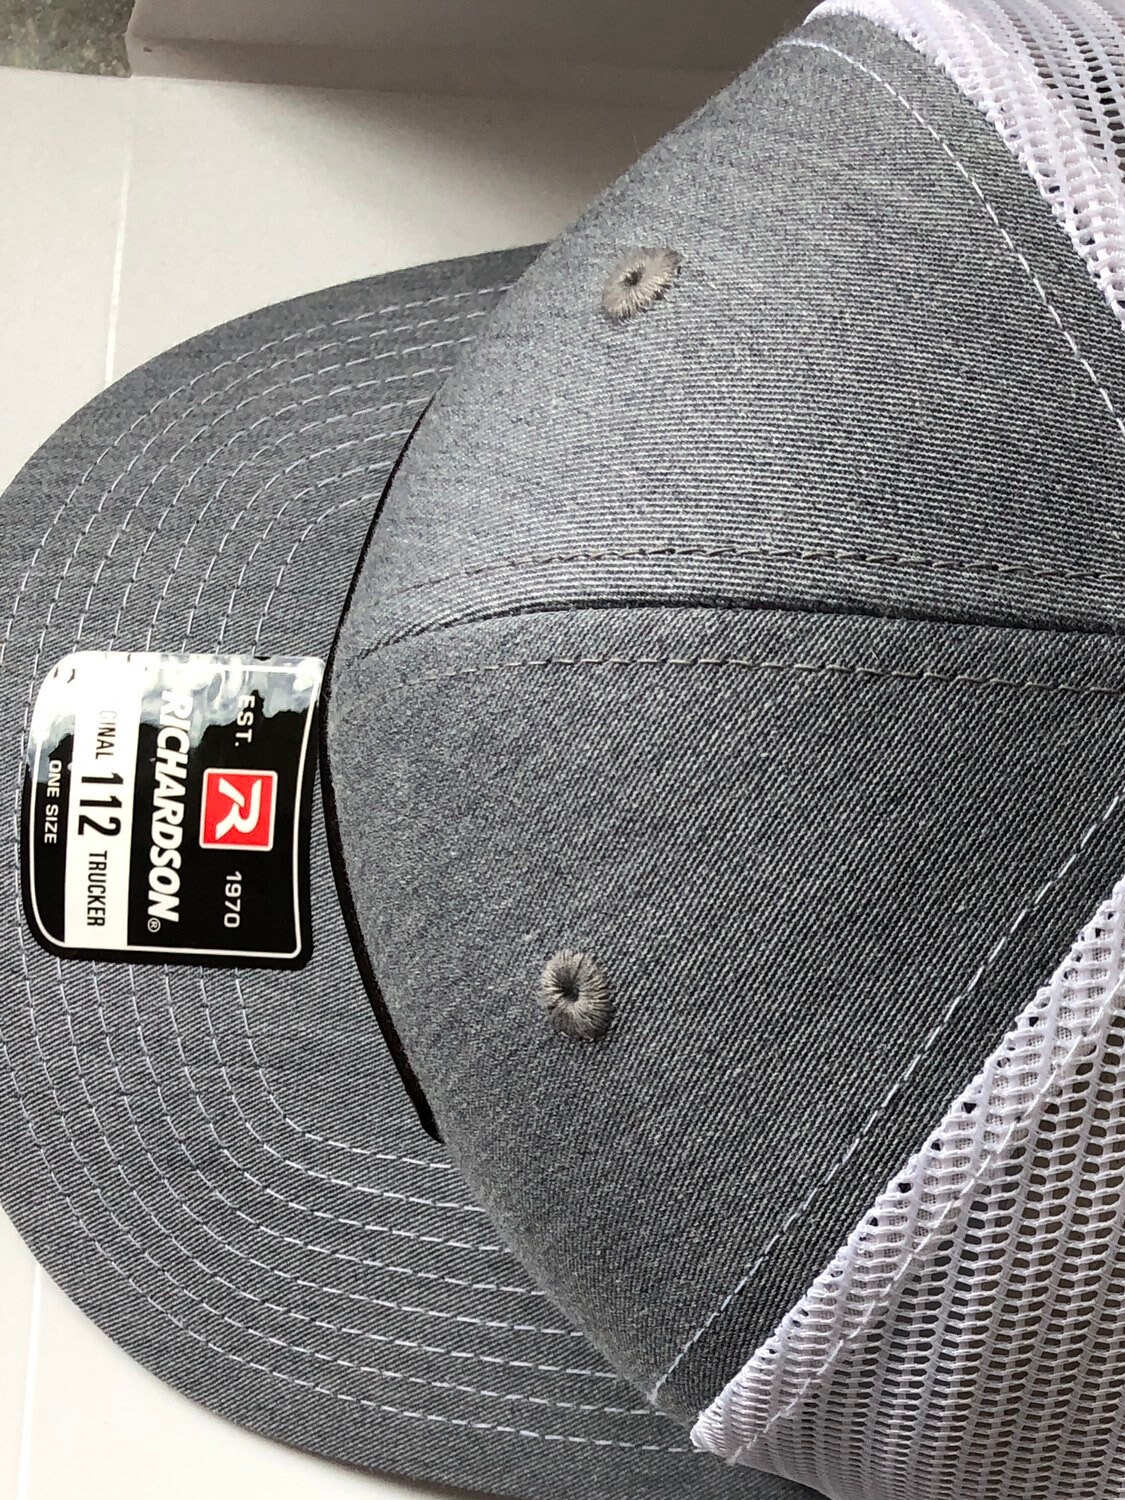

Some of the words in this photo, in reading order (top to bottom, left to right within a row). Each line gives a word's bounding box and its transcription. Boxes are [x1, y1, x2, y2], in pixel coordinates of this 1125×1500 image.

[235, 694, 256, 747] EST.
[46, 759, 63, 798] ONE
[77, 771, 124, 837] 112
[44, 803, 60, 844] SIZE
[215, 777, 263, 841] R
[86, 850, 108, 927] TRUCKER
[223, 870, 243, 929] 1970
